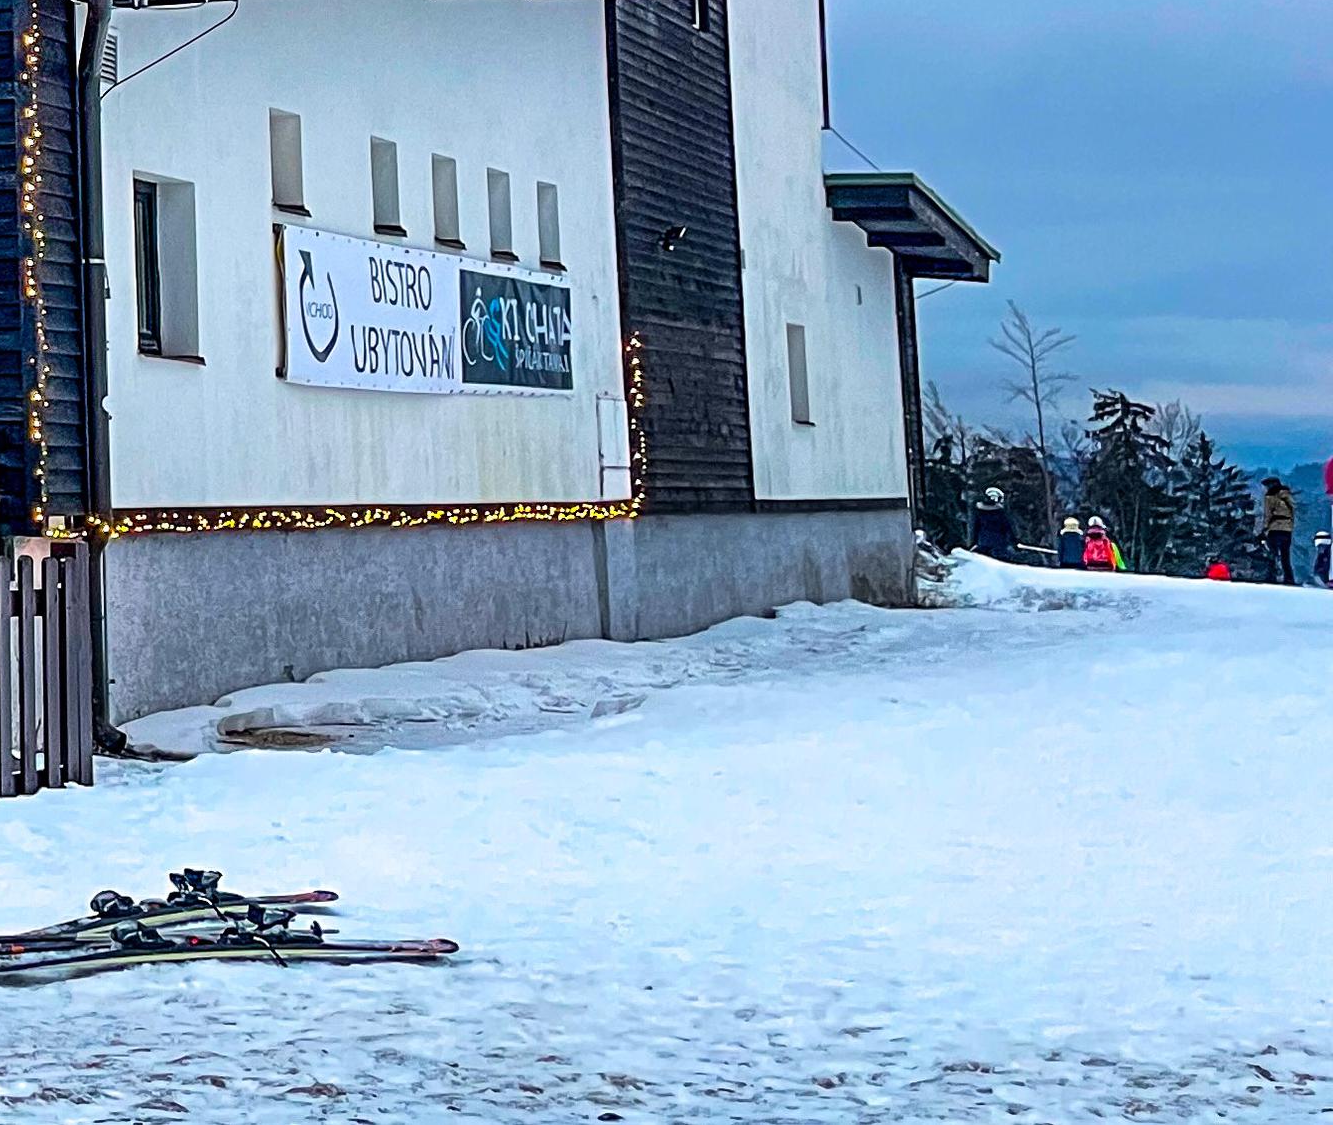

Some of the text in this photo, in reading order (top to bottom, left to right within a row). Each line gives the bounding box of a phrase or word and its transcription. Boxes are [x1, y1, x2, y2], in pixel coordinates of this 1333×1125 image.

[368, 256, 432, 311] BISTRO
[525, 301, 572, 347] CHATA
[350, 324, 456, 380] UBYTOVÁNÍ
